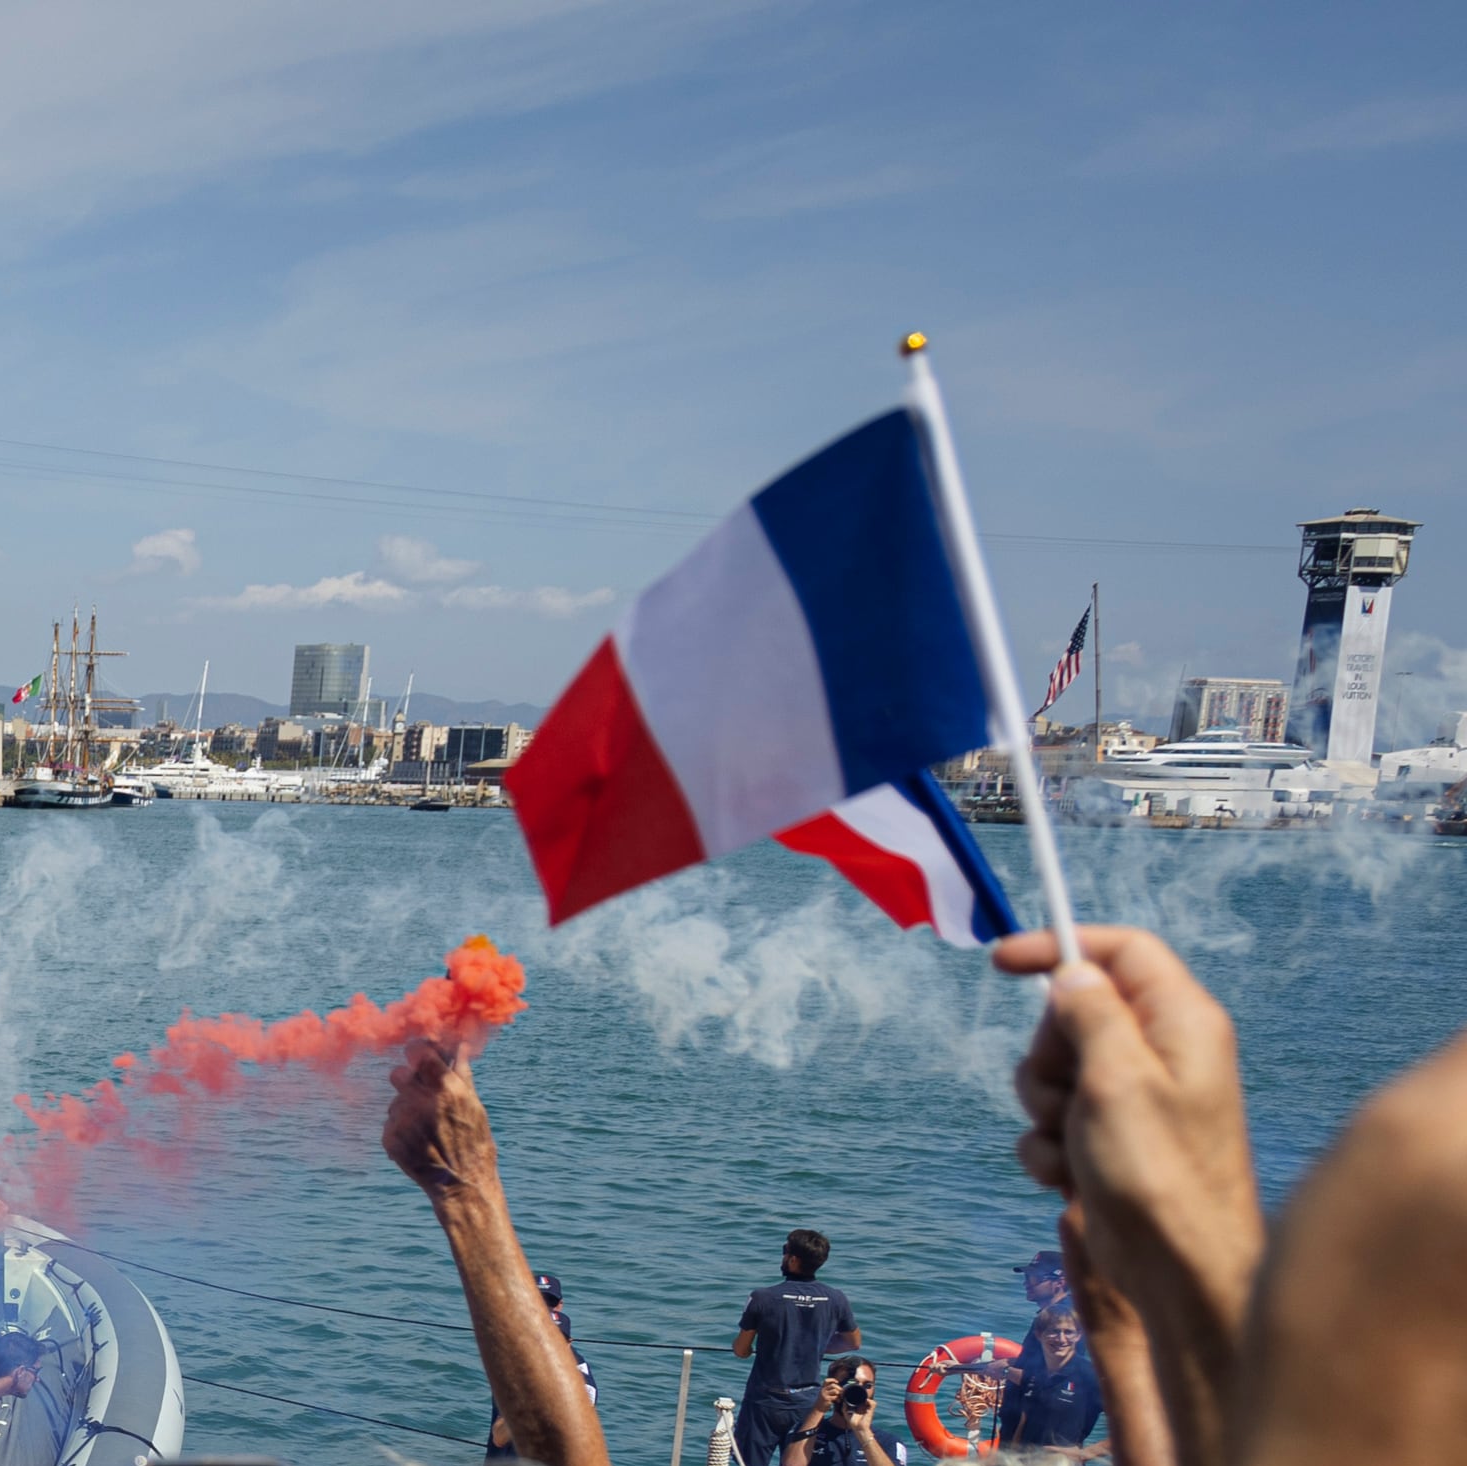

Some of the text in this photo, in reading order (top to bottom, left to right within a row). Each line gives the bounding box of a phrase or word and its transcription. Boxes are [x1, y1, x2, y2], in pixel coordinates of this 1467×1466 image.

[1354, 673, 1363, 681] IN
[1347, 682, 1368, 691] LOUIS
[1342, 691, 1372, 700] VUITTON
